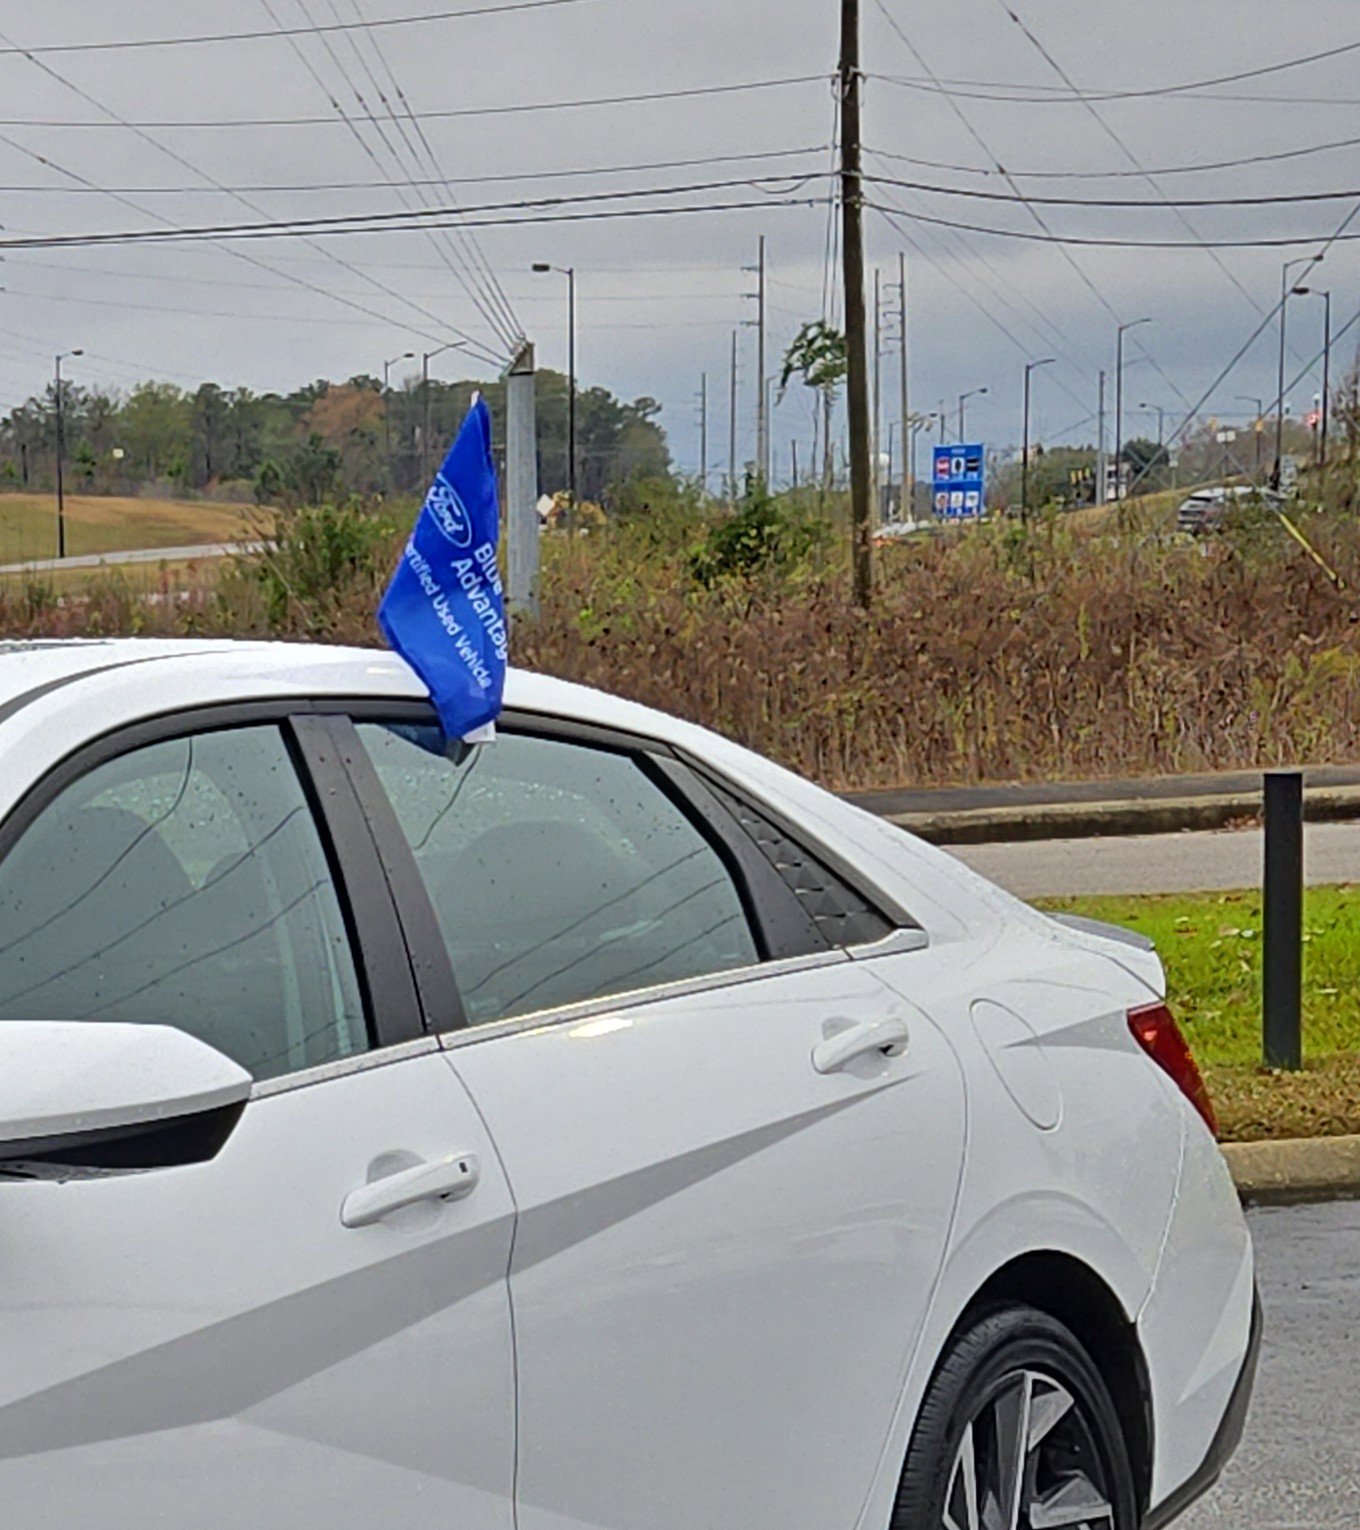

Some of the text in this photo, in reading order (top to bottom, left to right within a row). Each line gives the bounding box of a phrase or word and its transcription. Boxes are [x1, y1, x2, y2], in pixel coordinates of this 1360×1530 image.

[425, 485, 464, 532] Ford
[474, 542, 503, 596] Blue
[405, 541, 493, 690] ertified Used Vehicle
[451, 558, 508, 660] Advantag
